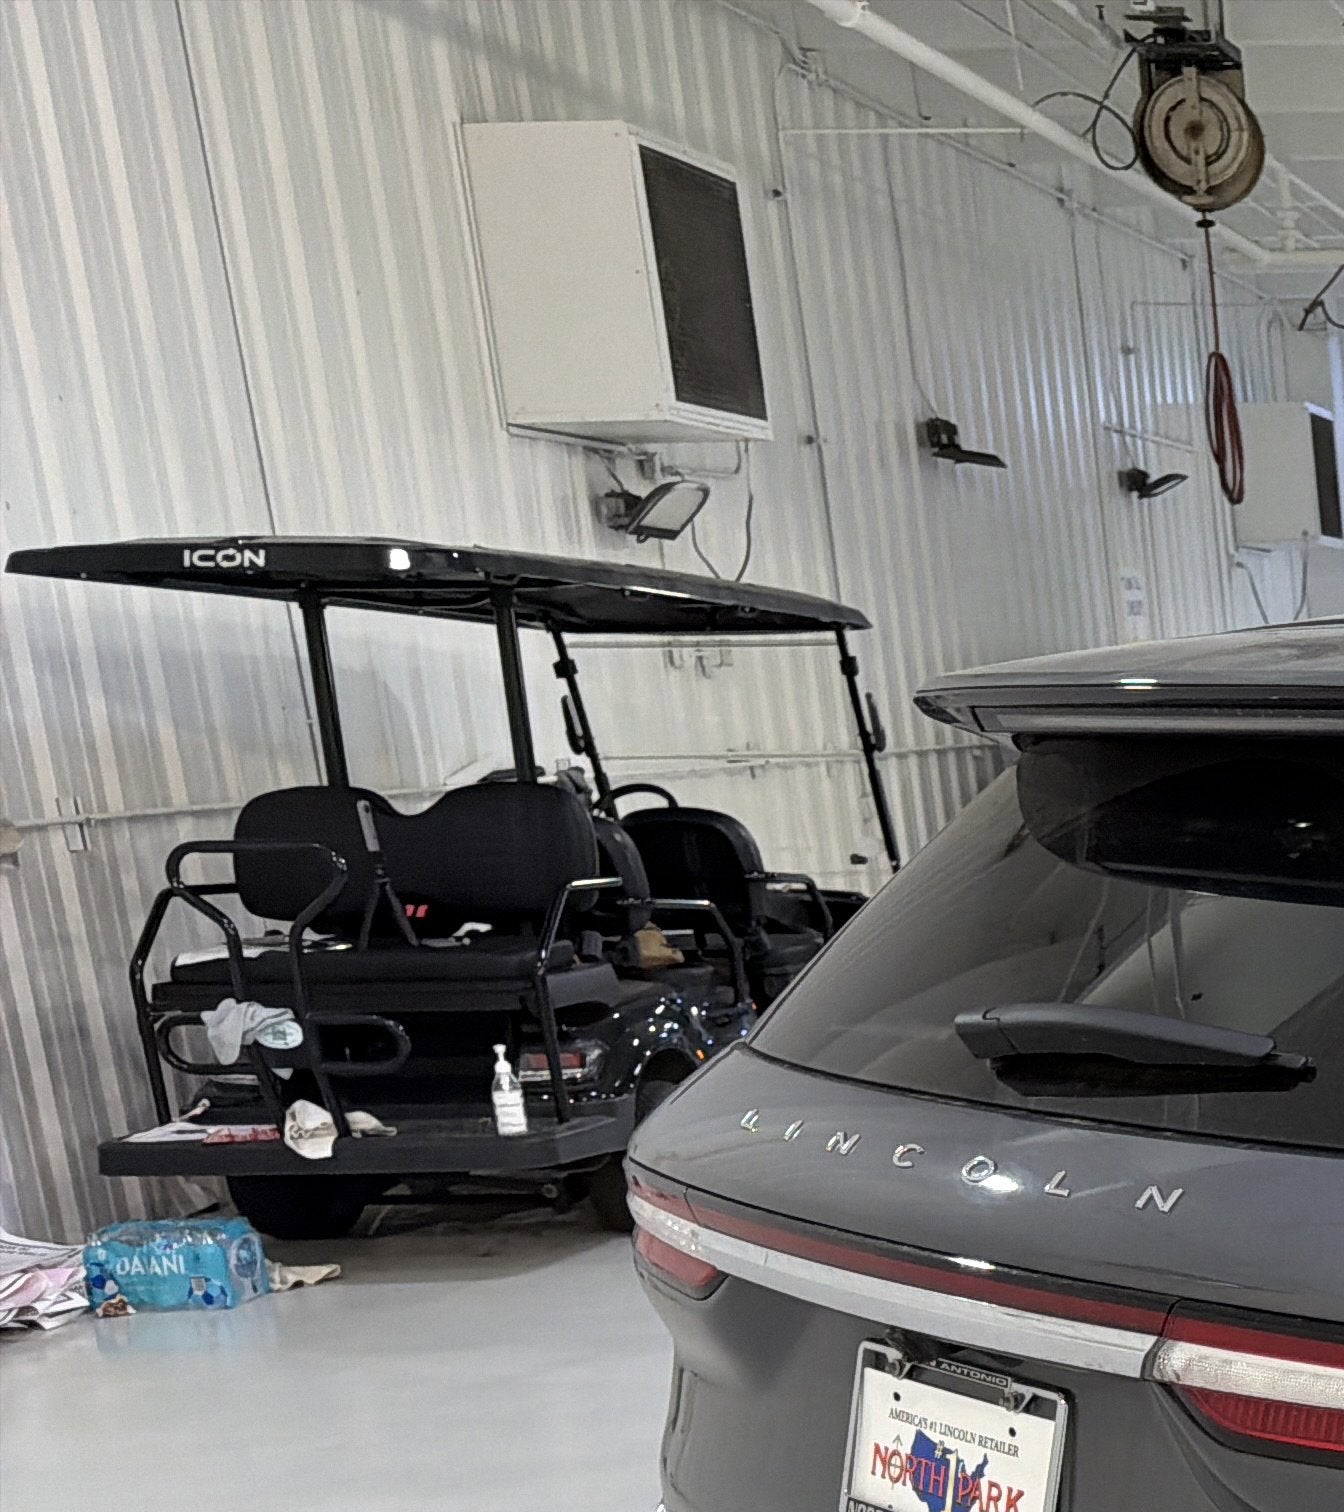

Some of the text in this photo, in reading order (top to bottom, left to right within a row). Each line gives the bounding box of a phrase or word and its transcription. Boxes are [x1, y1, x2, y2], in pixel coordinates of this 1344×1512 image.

[183, 547, 266, 568] ICON
[740, 1108, 1185, 1214] LINCOLN
[940, 1362, 1008, 1386] ANTONIO
[888, 1407, 1020, 1458] AMERICA'S #1 LINCOLN RETAILER
[871, 1442, 946, 1499] NORTH
